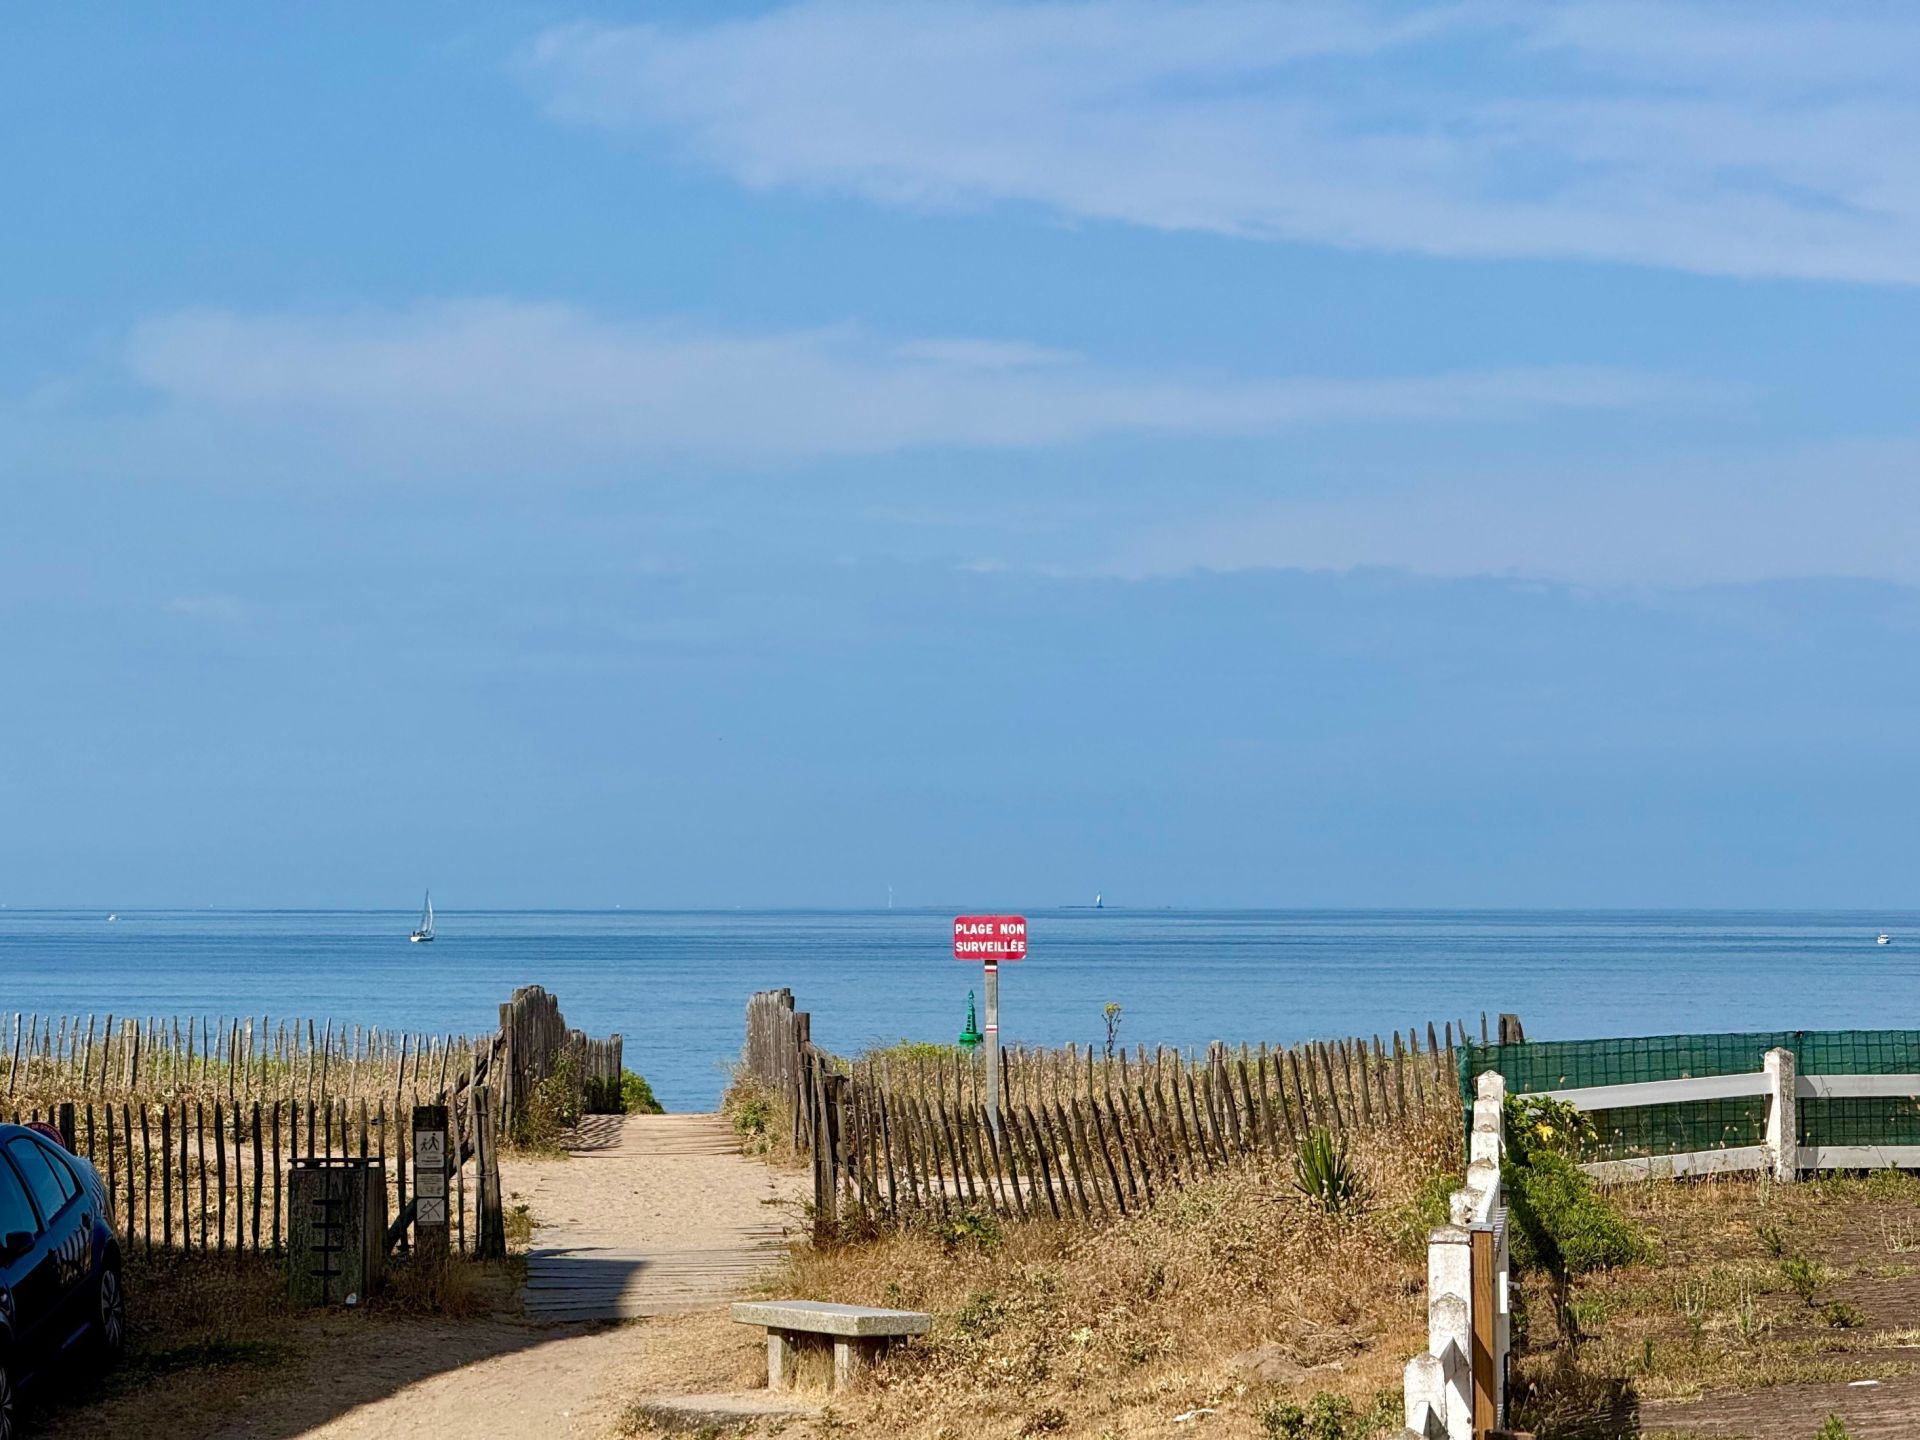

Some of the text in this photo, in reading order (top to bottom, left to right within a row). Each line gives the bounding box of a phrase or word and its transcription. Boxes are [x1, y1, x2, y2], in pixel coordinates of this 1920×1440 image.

[955, 923, 1025, 935] PLAGE NON
[955, 939, 1025, 952] SURVEILLÉE
